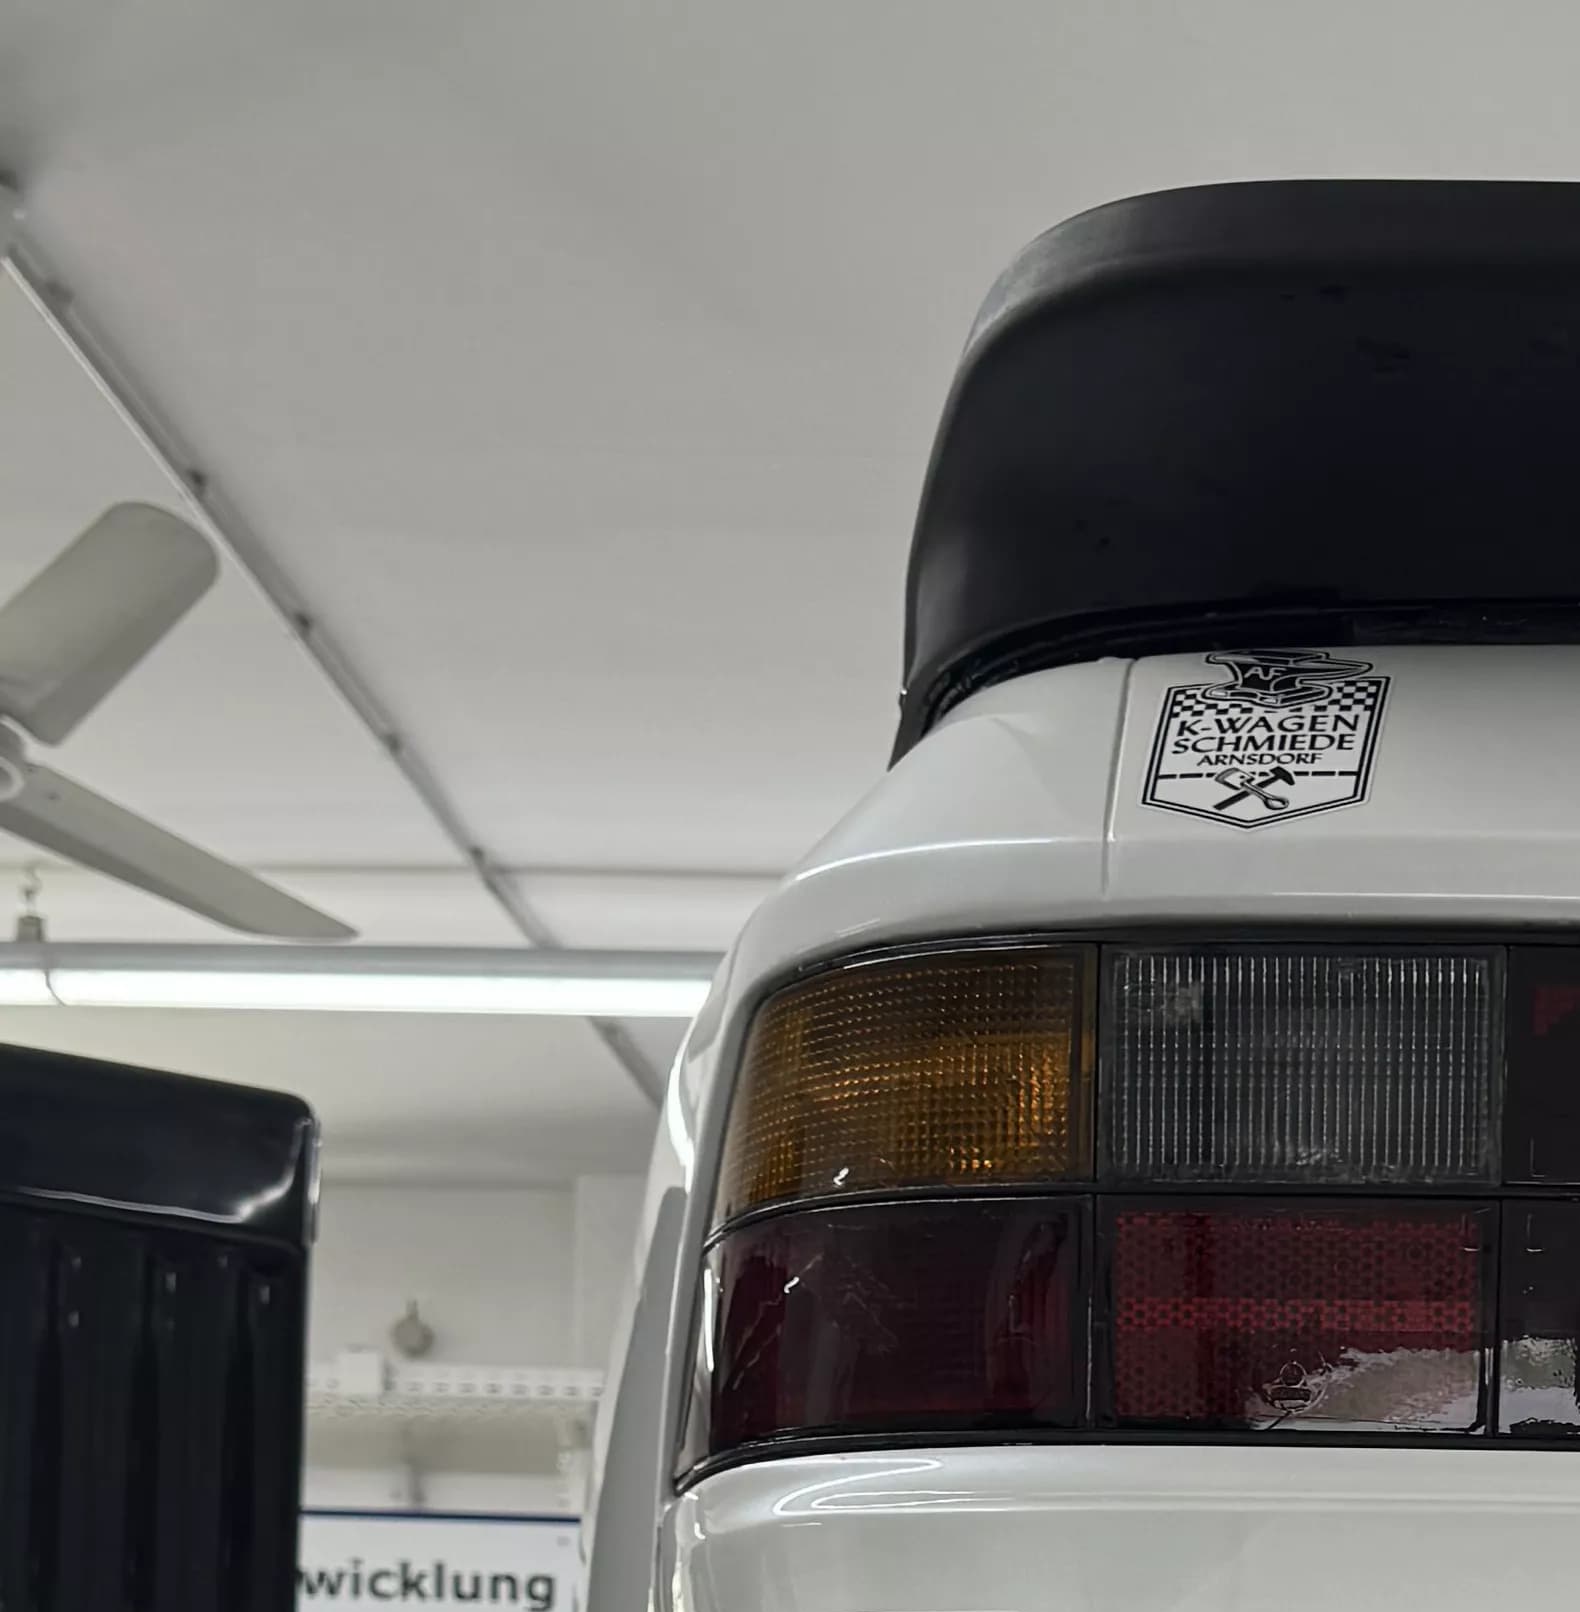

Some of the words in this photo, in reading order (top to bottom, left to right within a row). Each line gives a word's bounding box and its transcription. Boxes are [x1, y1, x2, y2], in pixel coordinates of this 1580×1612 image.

[1176, 713, 1360, 737] K-WAGEN
[1171, 733, 1356, 755] SCHMIEDE
[1197, 752, 1323, 767] ARNSDORF
[298, 1558, 557, 1612] wicklung
